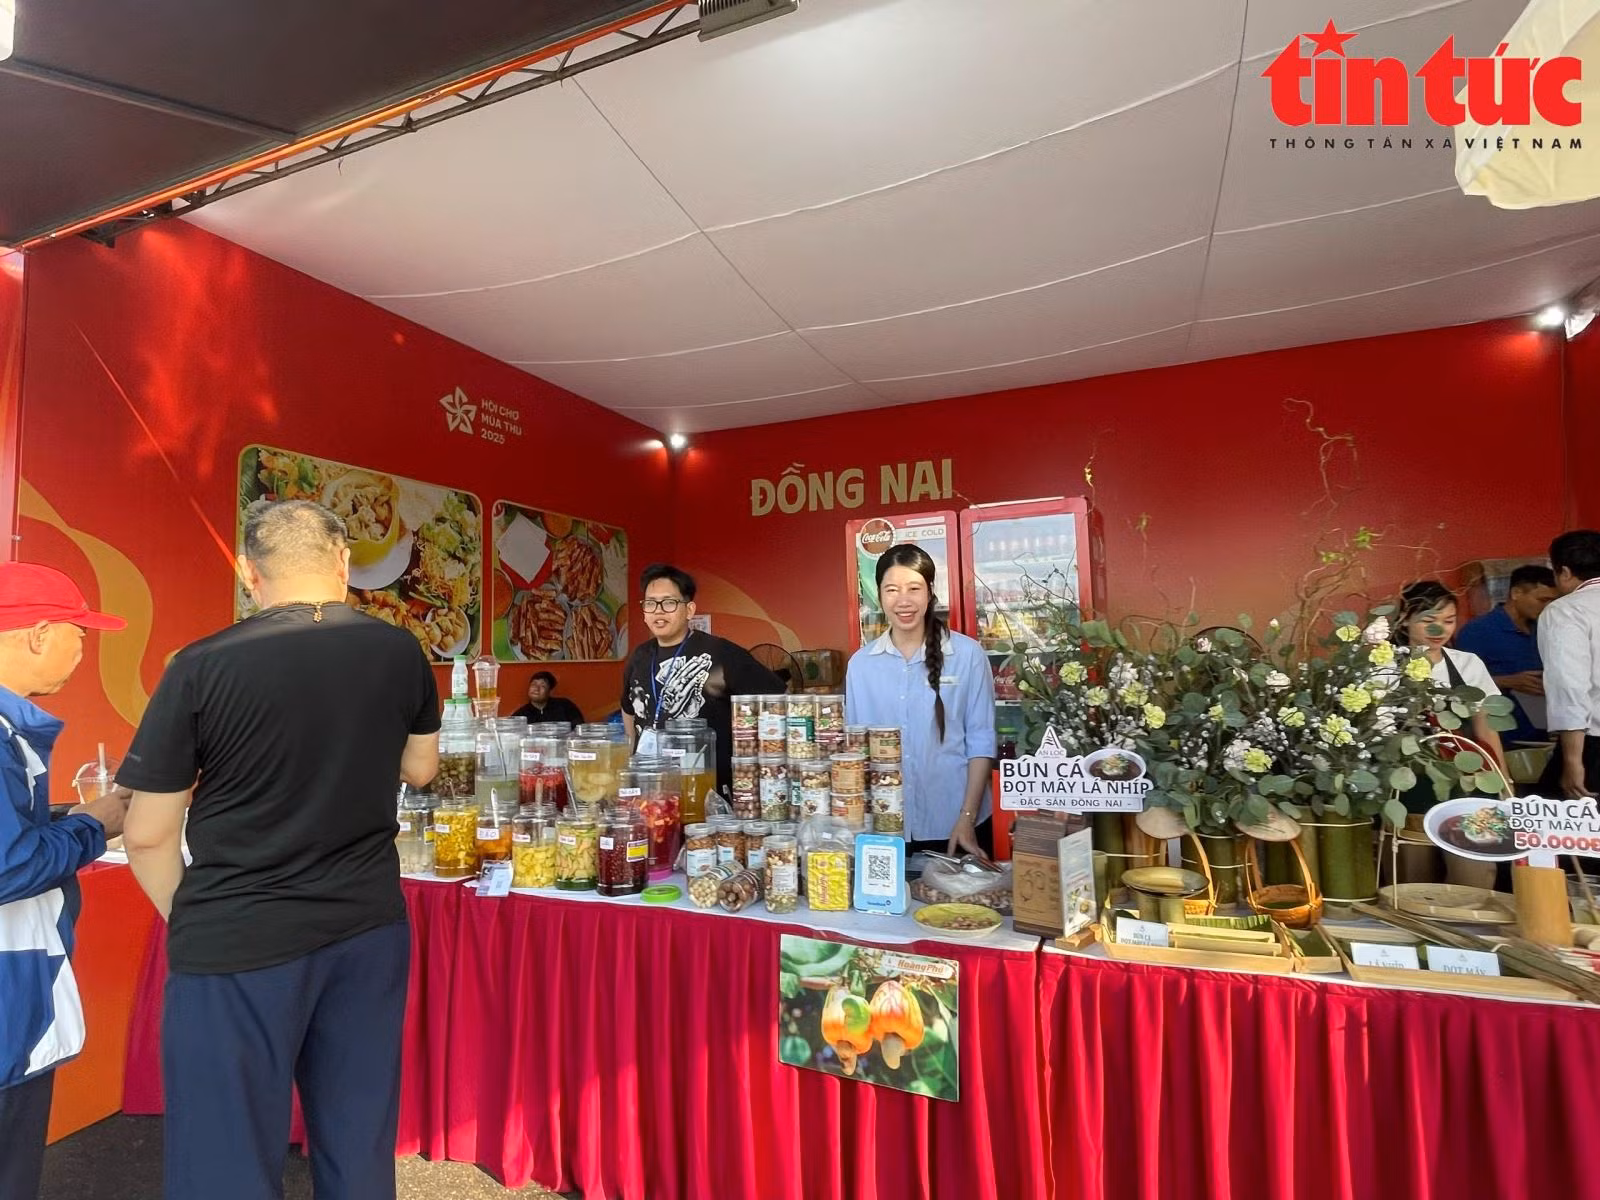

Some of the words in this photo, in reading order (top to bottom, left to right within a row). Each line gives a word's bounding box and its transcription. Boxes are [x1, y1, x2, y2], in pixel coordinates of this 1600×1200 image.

[481, 428, 505, 445] 2025
[503, 421, 522, 436] THU
[750, 462, 865, 517] ĐỒNG
[880, 458, 953, 504] NAI
[921, 528, 944, 537] COLD
[1003, 758, 1048, 778] BÚN
[1056, 758, 1084, 778] CÁ
[1003, 780, 1036, 796] ĐỌT
[1041, 778, 1076, 794] MÂY
[1081, 777, 1102, 794] LÁ
[1107, 779, 1149, 795] NHÍP
[1105, 799, 1122, 808] NAI
[1512, 799, 1558, 818] BÚN
[1566, 802, 1595, 820] CÁ
[1511, 818, 1543, 831] ĐỌT
[1549, 818, 1583, 832] MÂY
